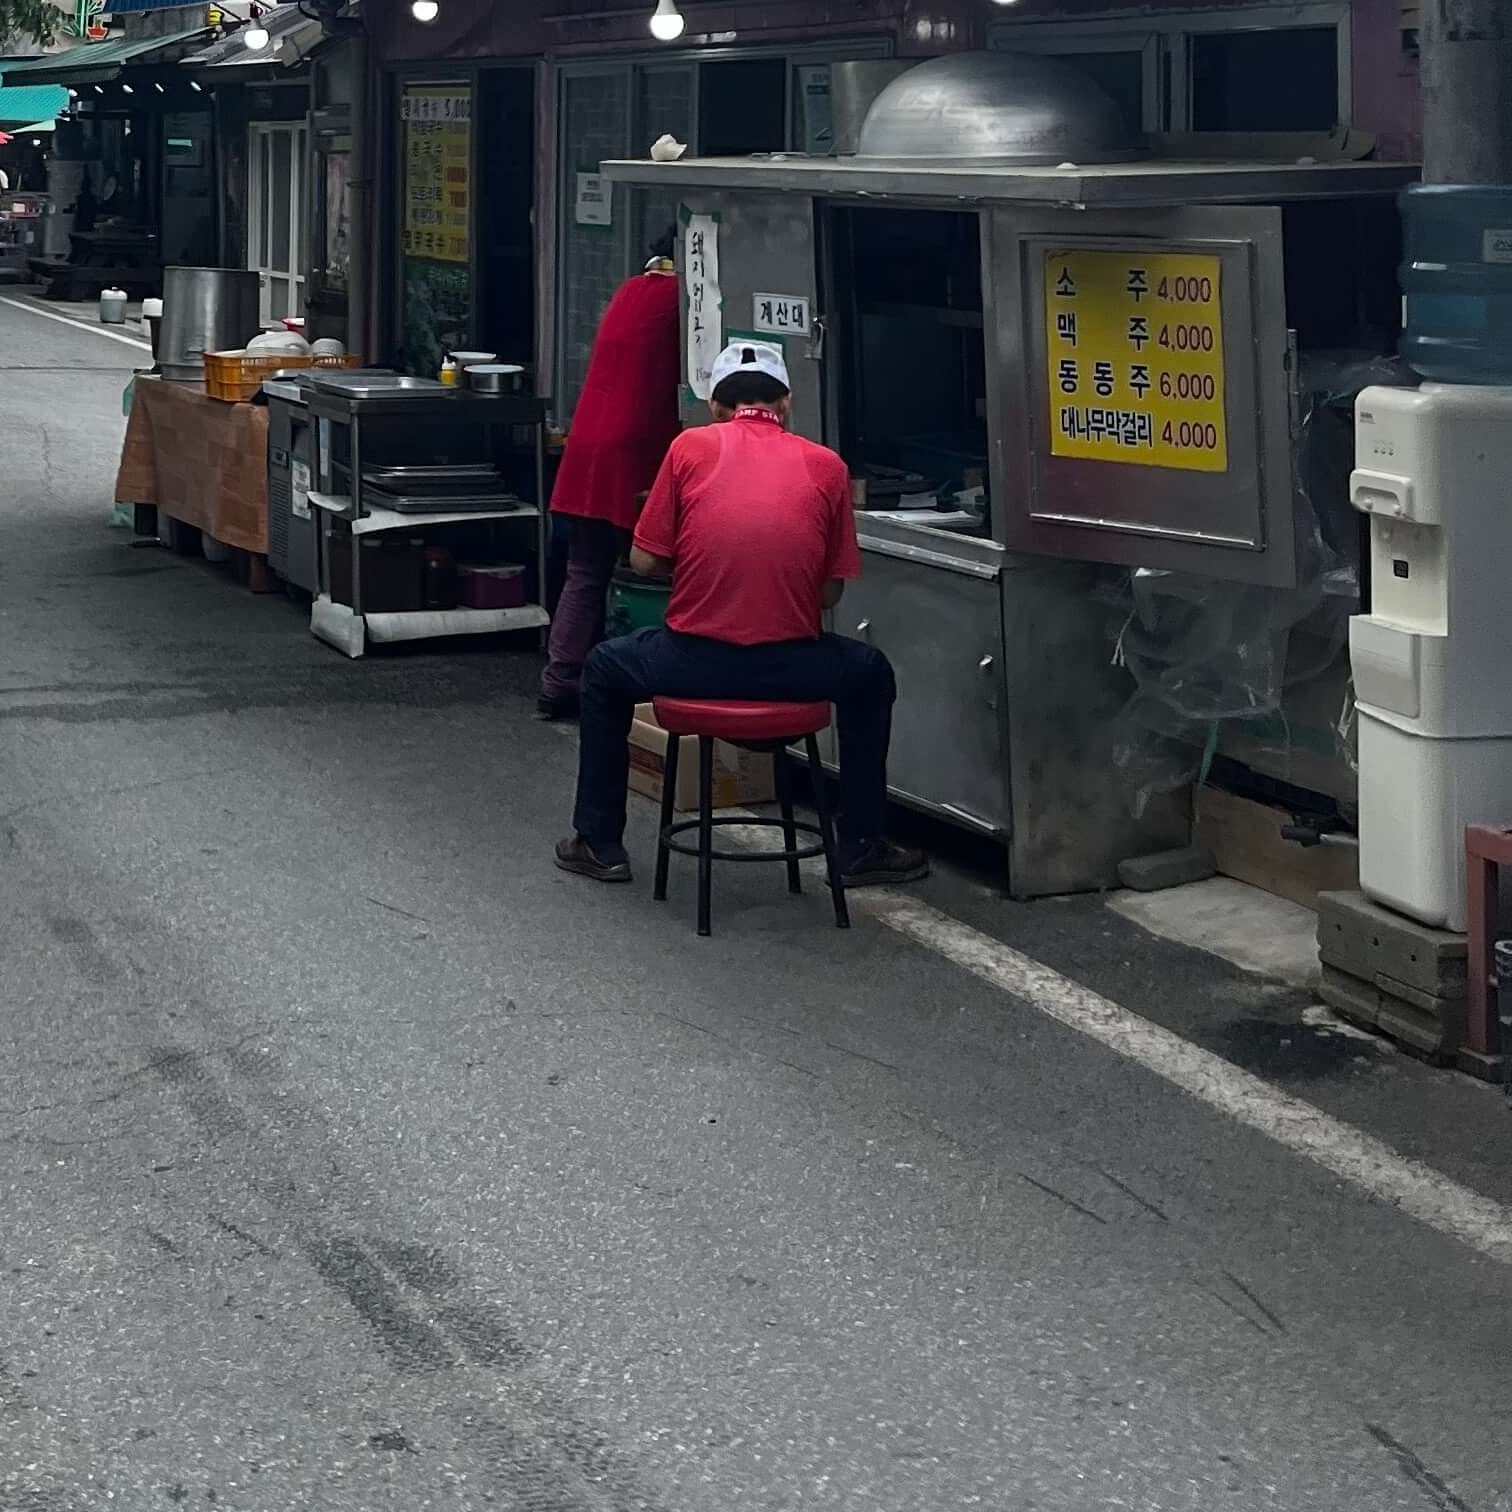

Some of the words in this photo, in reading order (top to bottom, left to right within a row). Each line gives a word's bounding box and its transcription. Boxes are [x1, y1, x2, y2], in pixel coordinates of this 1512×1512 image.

[1157, 275, 1212, 303] 4,000
[760, 300, 804, 329] 계산대
[1158, 324, 1214, 352] 4,000
[1159, 371, 1216, 401] 6,000
[1060, 405, 1153, 448] 대나무막걸리
[1161, 420, 1217, 450] 4,000
